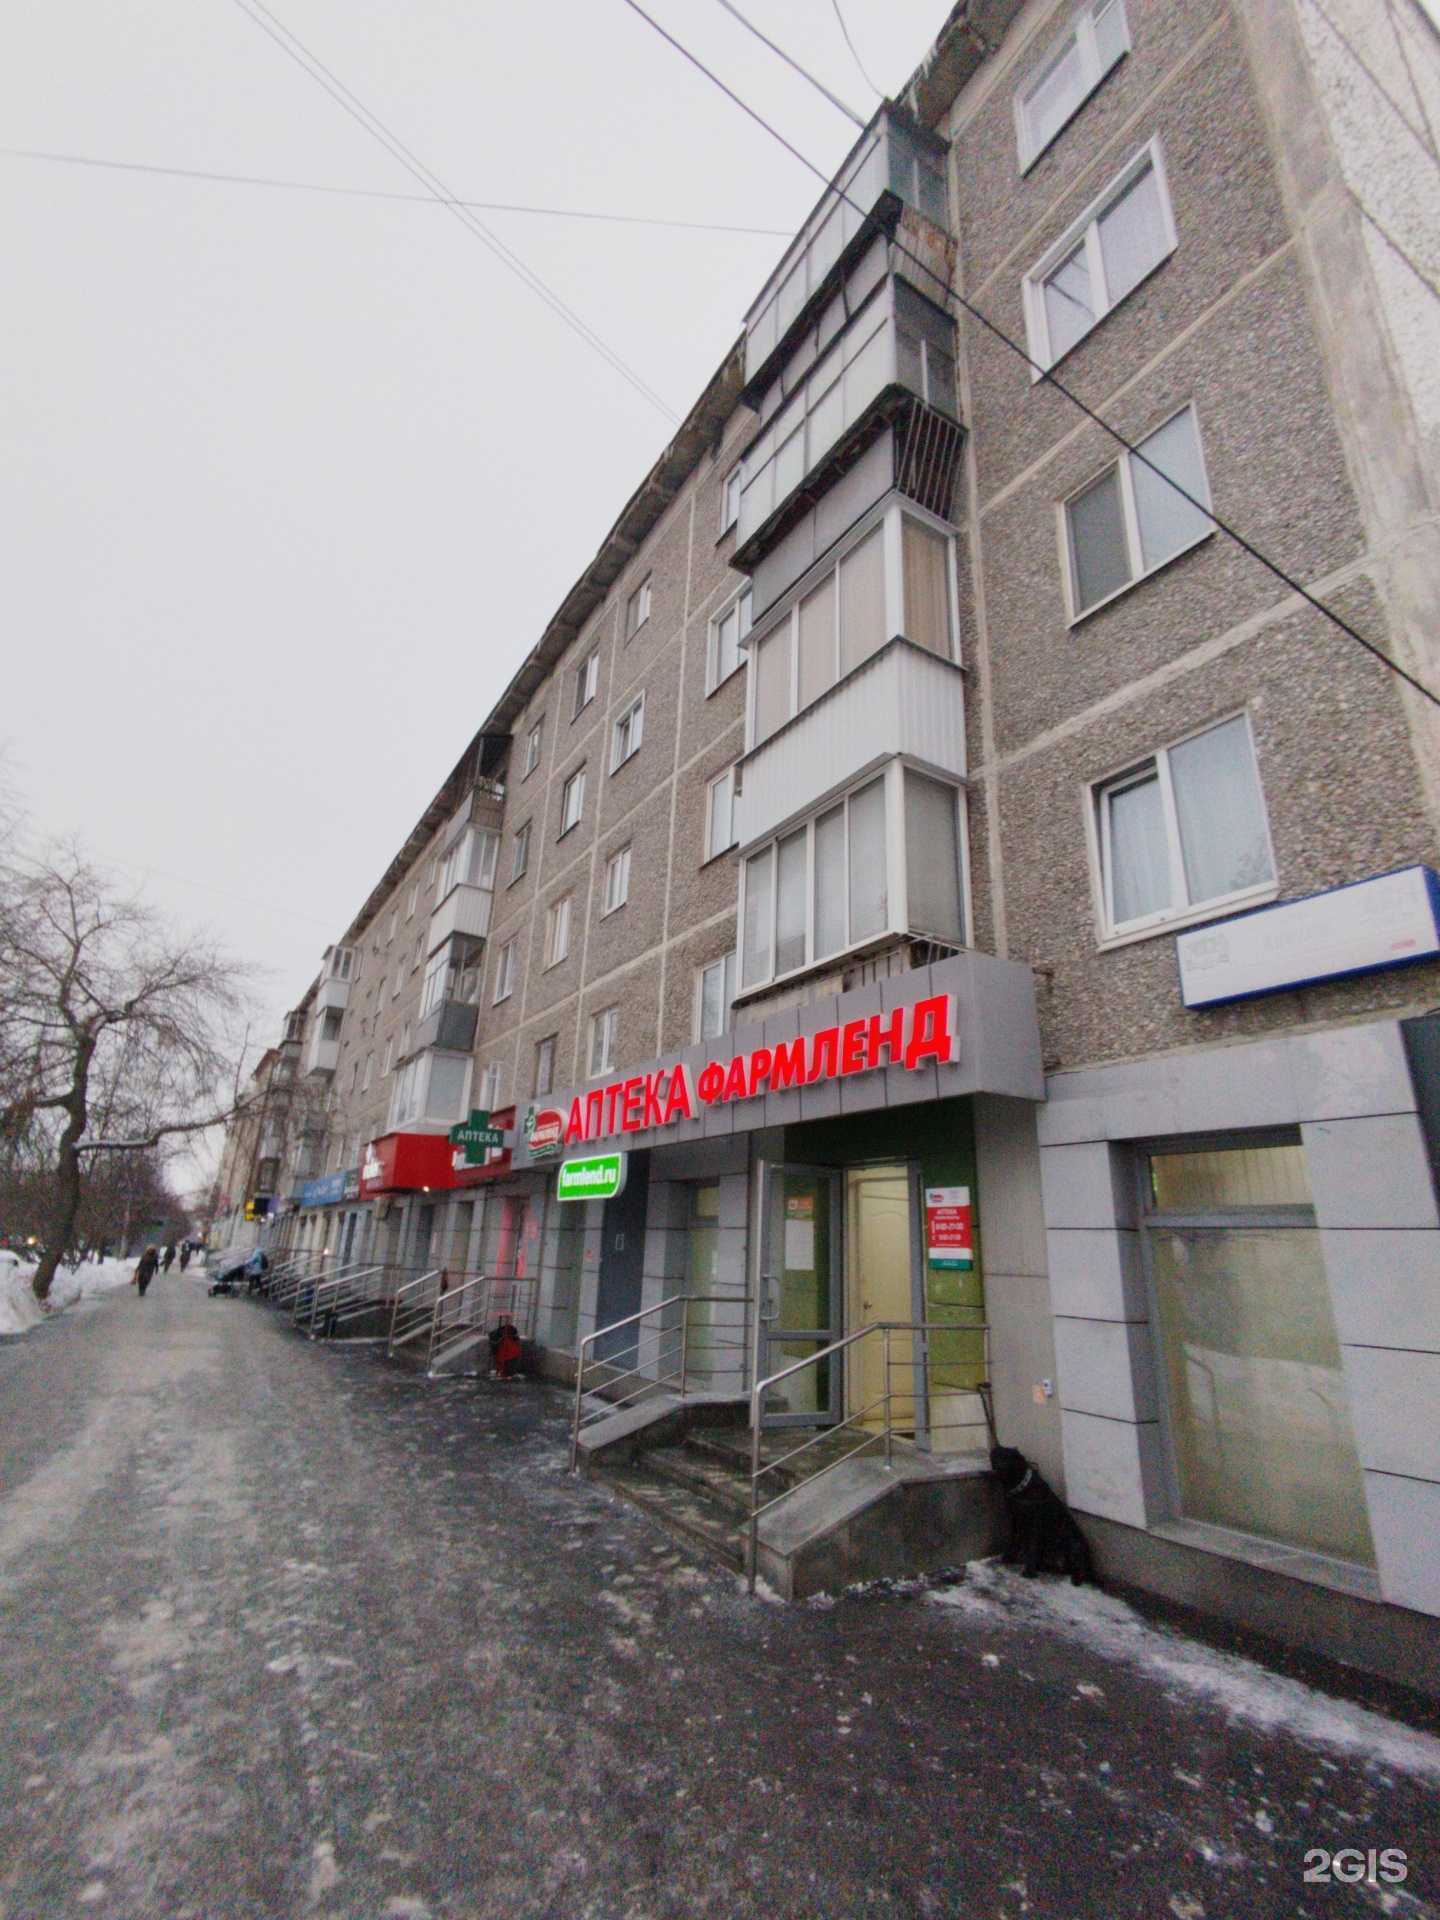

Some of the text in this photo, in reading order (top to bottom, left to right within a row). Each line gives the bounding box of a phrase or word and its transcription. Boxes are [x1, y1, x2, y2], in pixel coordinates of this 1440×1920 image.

[563, 994, 954, 1146] АПТЕКА ФАРМЛЕНД
[456, 1130, 499, 1144] АПТЕКА
